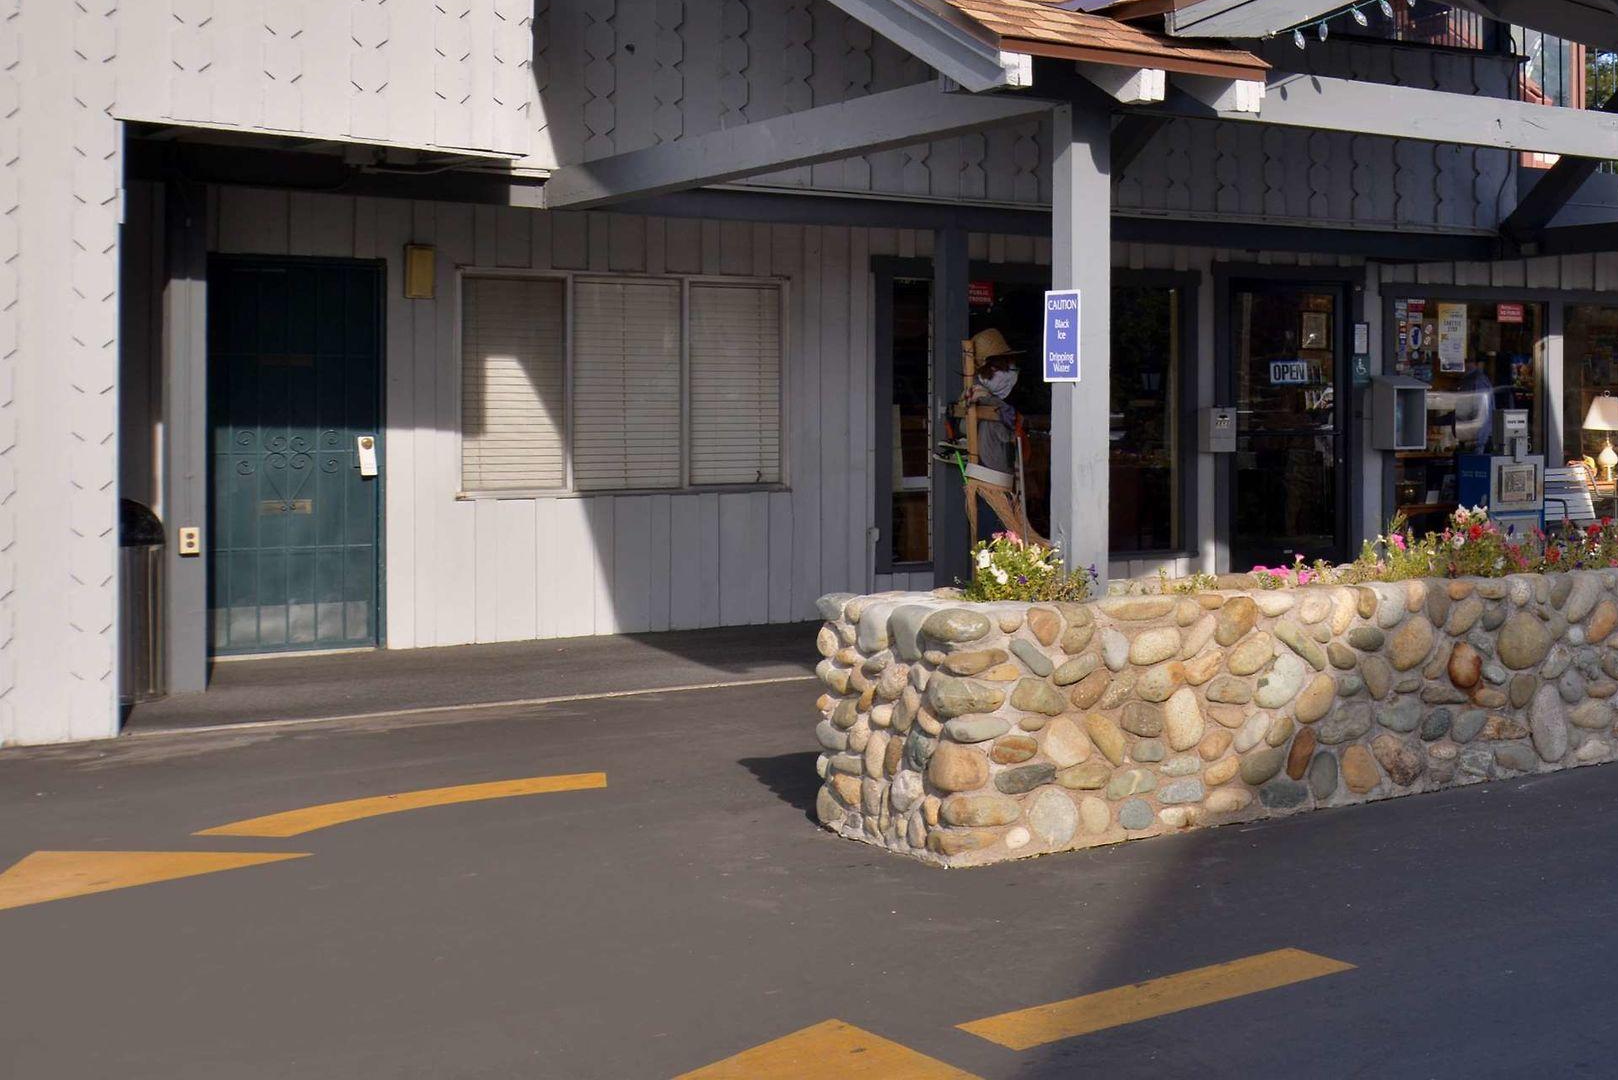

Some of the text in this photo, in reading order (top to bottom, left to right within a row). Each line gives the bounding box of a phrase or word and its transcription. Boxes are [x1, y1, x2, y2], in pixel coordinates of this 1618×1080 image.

[1047, 299, 1077, 311] CAUTION
[1054, 318, 1070, 329] Black
[1057, 330, 1066, 340] Ice
[1049, 352, 1075, 364] Dripping
[1053, 363, 1071, 373] Water
[1273, 364, 1305, 381] OPEN
